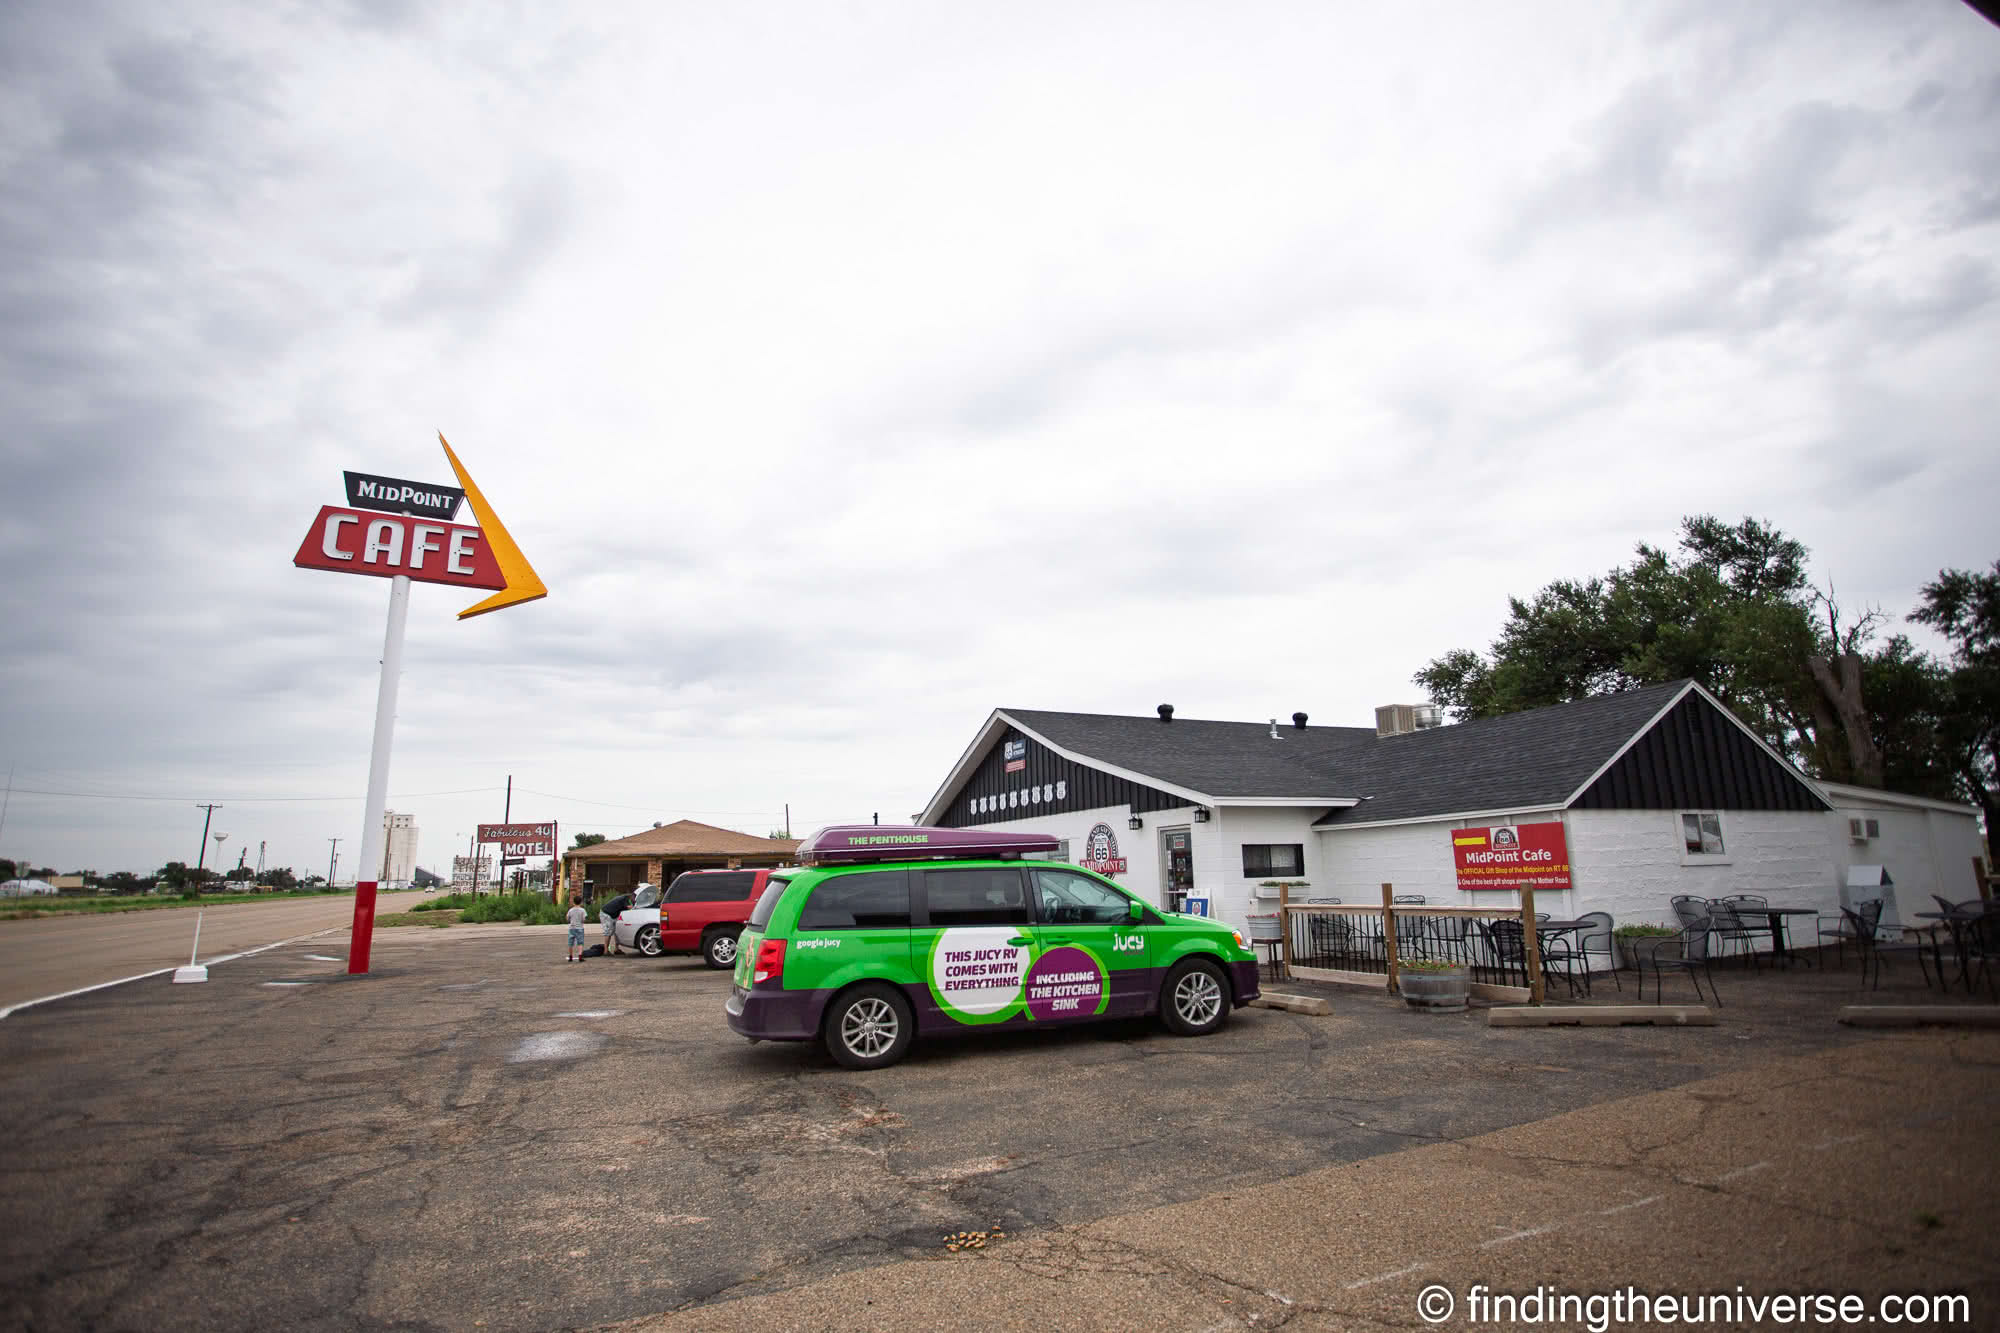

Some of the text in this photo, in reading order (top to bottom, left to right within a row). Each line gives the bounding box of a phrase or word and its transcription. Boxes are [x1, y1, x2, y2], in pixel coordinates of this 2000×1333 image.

[322, 513, 479, 575] CAFE
[483, 826, 552, 838] Fabulous 40
[848, 834, 928, 845] THE PENTHOUSE
[505, 842, 552, 855] MOTEL
[1095, 848, 1107, 860] 66
[1466, 849, 1552, 864] MidPoint Cafe
[796, 938, 841, 949] google jucy
[945, 948, 1018, 962] THIS JUCY RV
[945, 962, 1018, 977] COMES WITH
[945, 976, 1019, 991] EVERYTHING
[1036, 971, 1095, 985] INCLUDING
[1030, 983, 1100, 999] THE KITCHEN
[1051, 998, 1080, 1011] SINK
